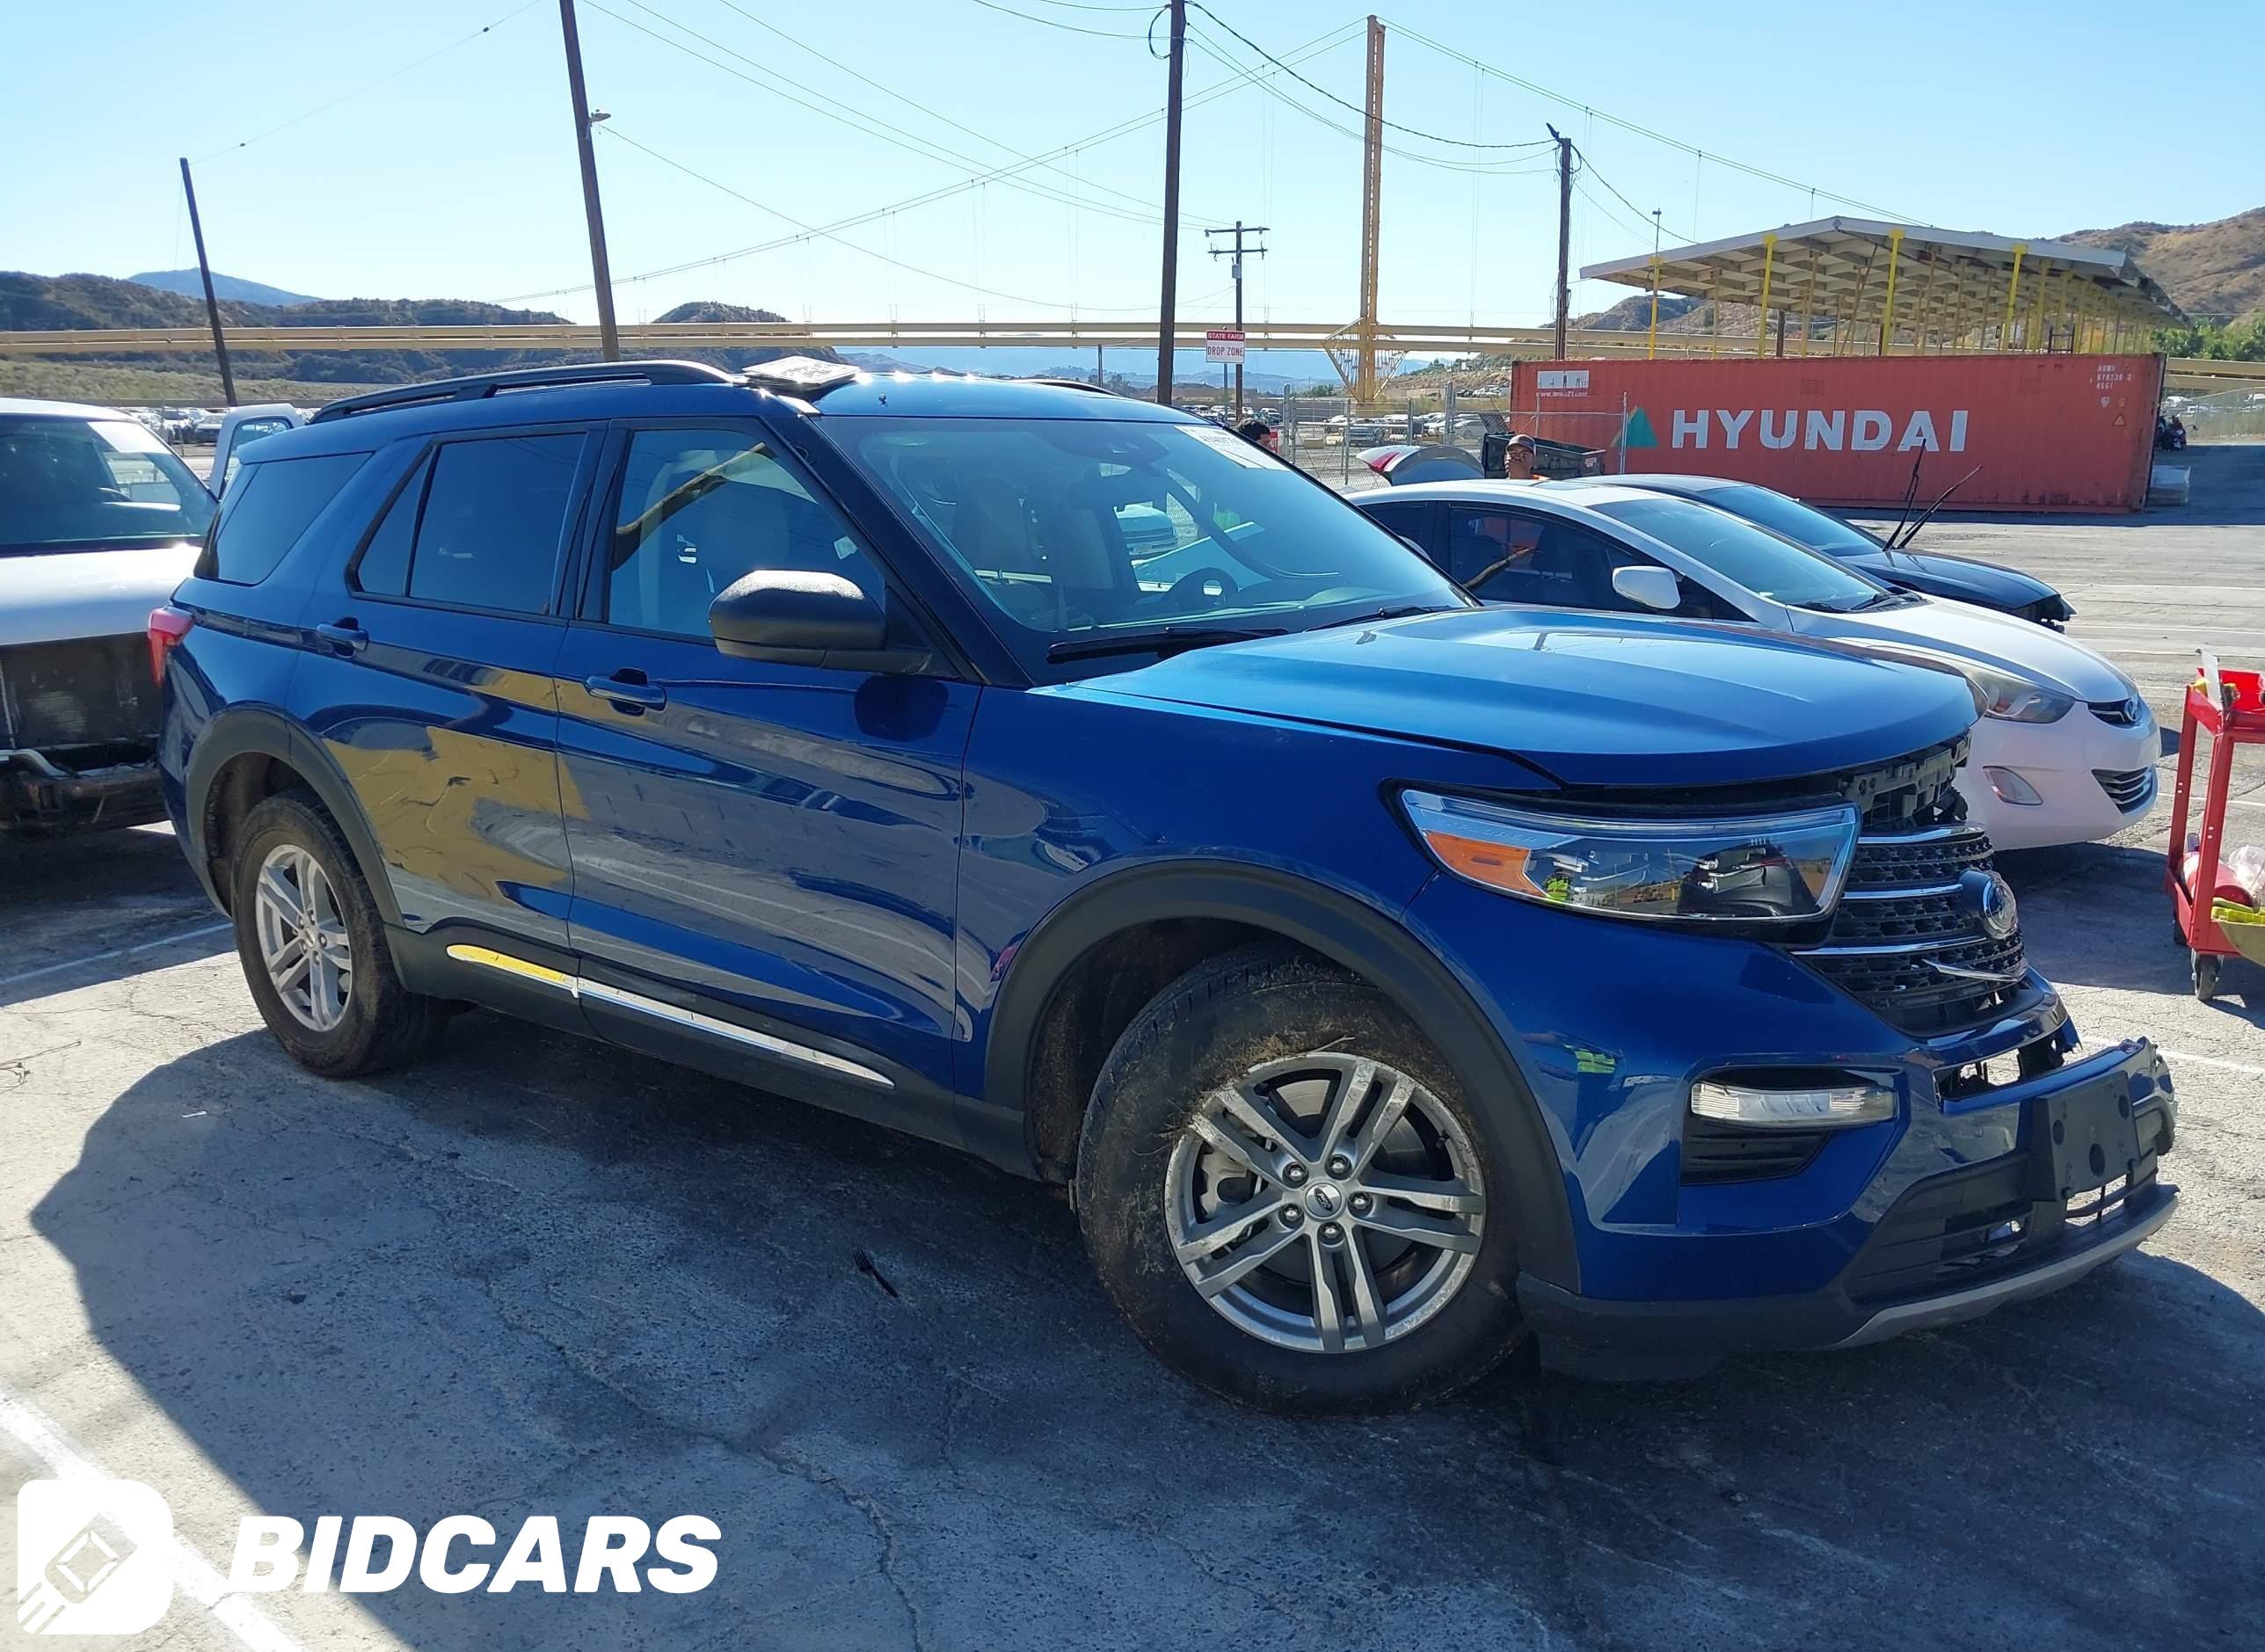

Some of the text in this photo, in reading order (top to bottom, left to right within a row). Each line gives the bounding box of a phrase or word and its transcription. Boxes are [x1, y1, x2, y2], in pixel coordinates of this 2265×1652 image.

[1207, 346, 1243, 356] DROP ZONE
[1671, 410, 1969, 452] HYUNDAI
